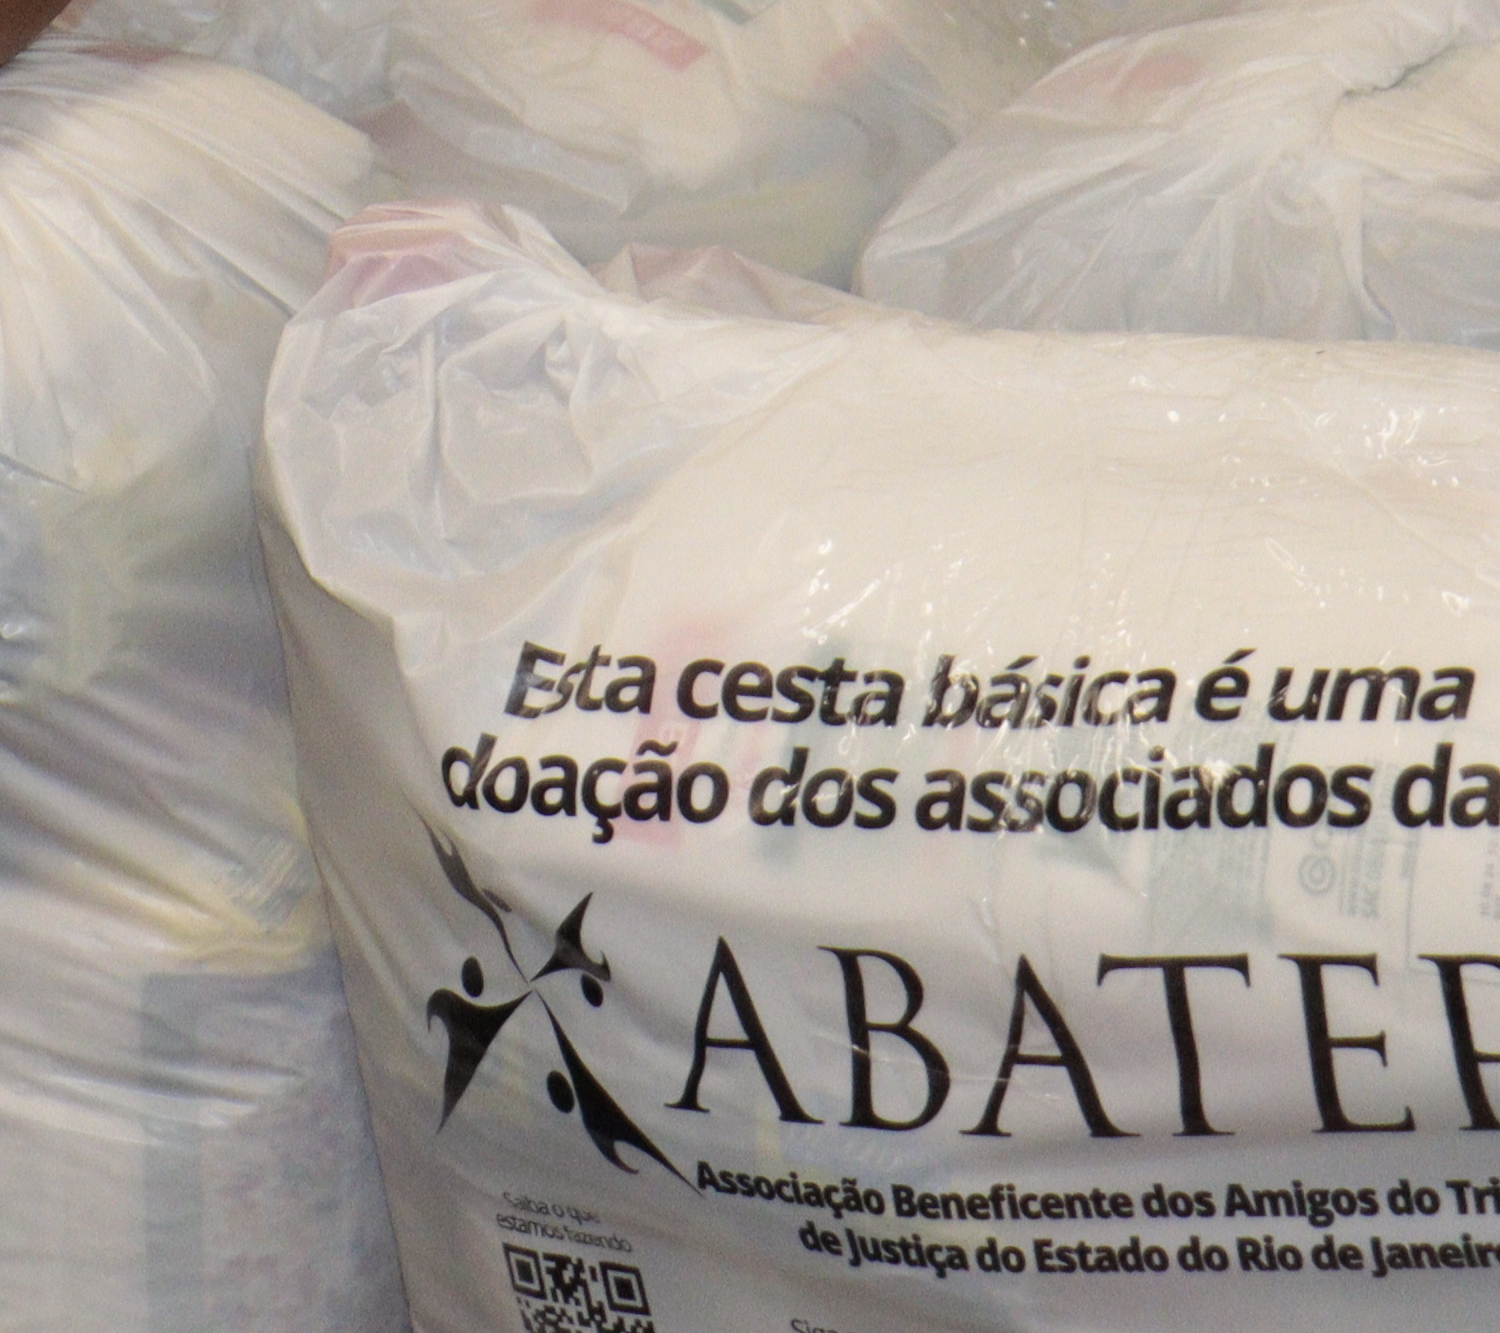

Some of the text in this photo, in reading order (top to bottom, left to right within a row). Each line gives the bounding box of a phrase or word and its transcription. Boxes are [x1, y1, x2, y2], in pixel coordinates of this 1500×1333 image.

[504, 640, 1476, 730] Esta cesta básica é uma
[440, 732, 730, 844] doação
[747, 746, 899, 830] dos
[914, 742, 1375, 833] associados
[697, 1160, 885, 1219] Associação
[891, 1184, 1134, 1221] Beneficente
[1142, 1183, 1216, 1219] dos
[1224, 1180, 1379, 1228] Amigos
[1387, 1179, 1441, 1216] do
[799, 1220, 843, 1257] de
[844, 1227, 969, 1278] Justiça
[975, 1236, 1026, 1274] do
[1033, 1235, 1169, 1274] Estado
[1177, 1236, 1229, 1273] do
[1236, 1235, 1303, 1272] Rio
[1312, 1234, 1364, 1272] de
